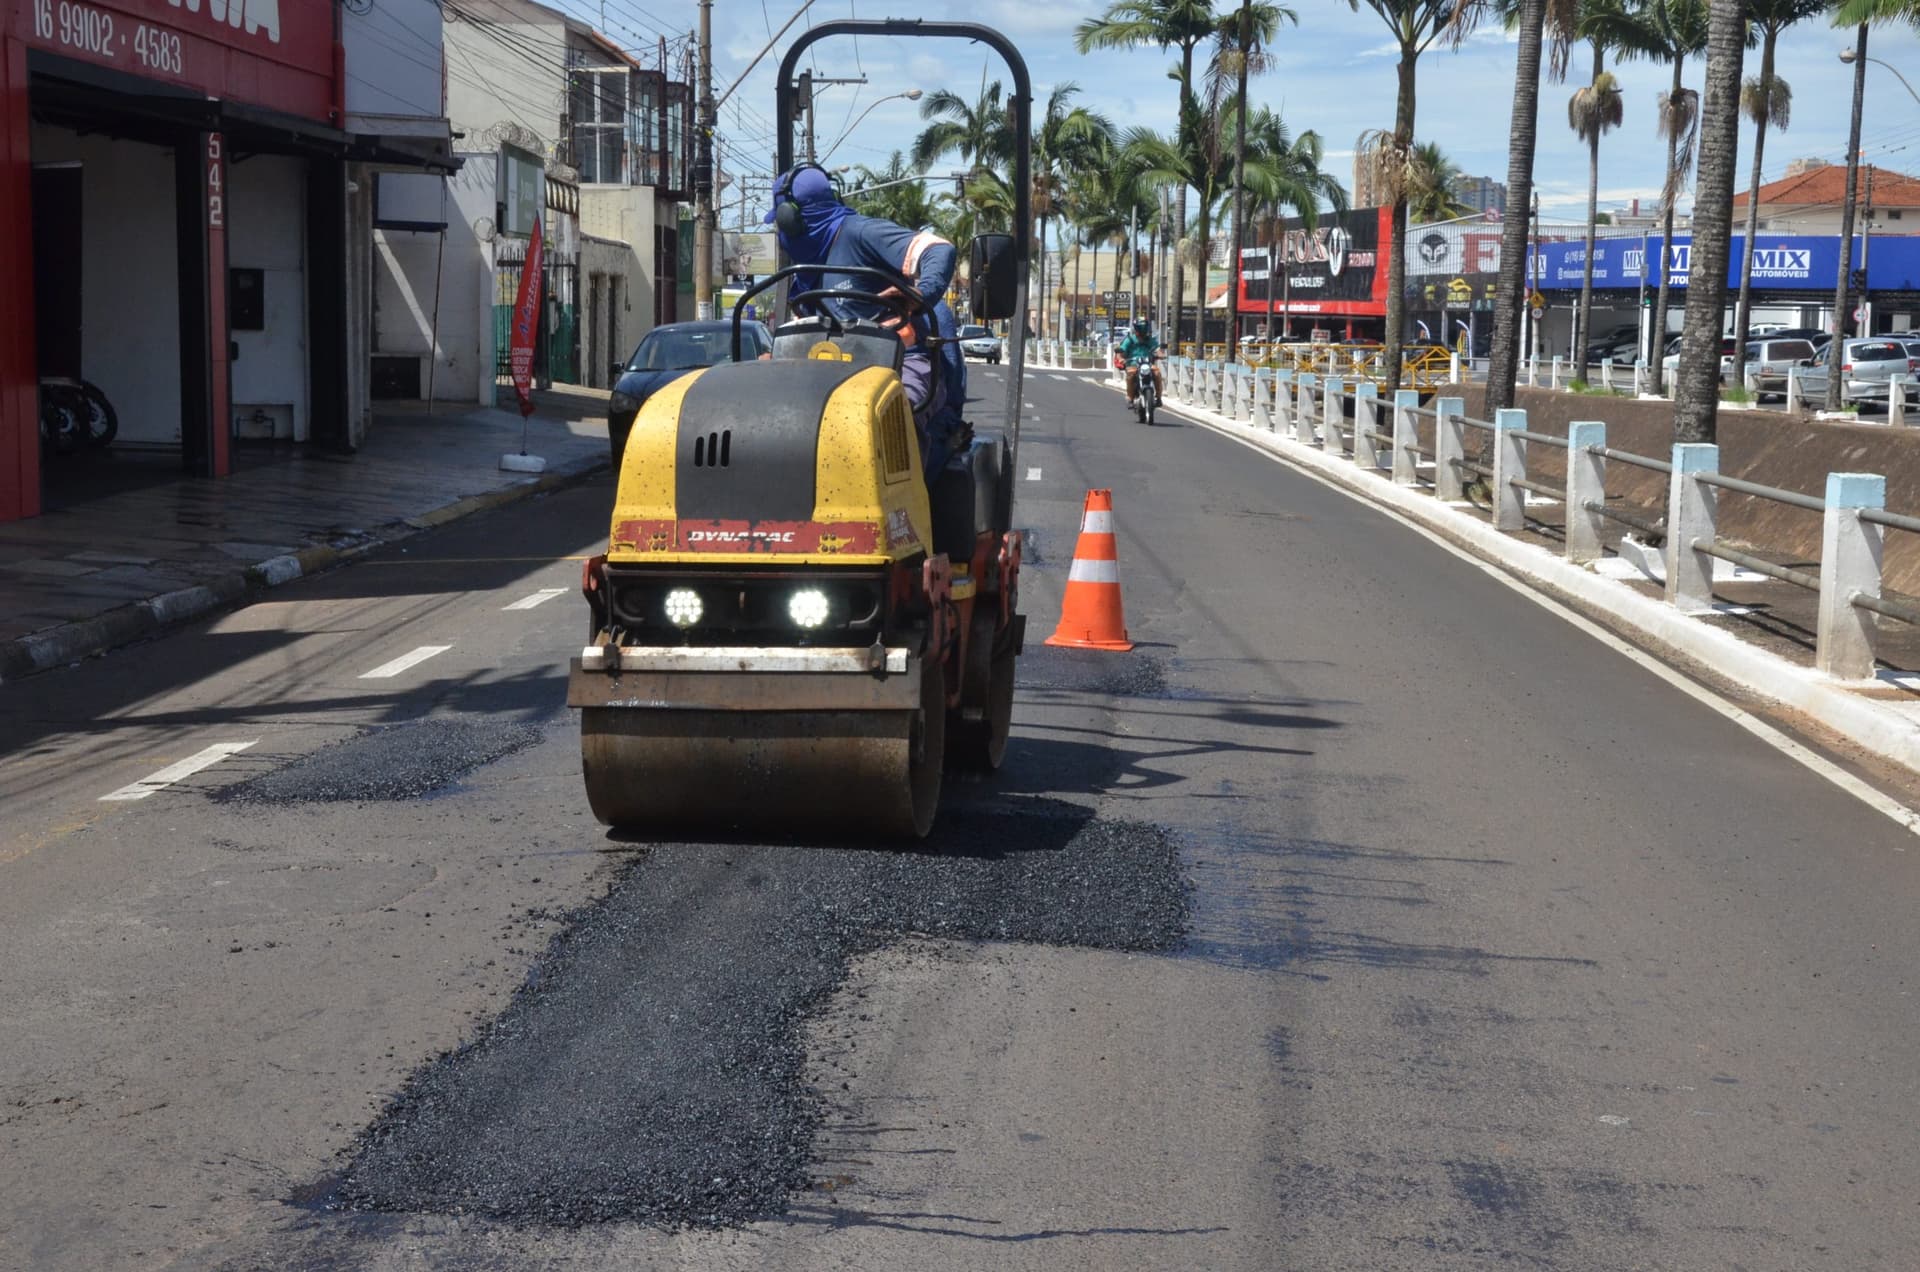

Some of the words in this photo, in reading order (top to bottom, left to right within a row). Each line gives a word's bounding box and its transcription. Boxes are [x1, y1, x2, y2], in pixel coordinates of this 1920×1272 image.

[34, 0, 53, 39] 16
[60, 1, 114, 57] 99102
[134, 25, 182, 74] 4583
[1753, 251, 1807, 268] MIX
[1750, 269, 1809, 278] AUTOMÓVEIS
[687, 530, 796, 543] DYNAPAC
